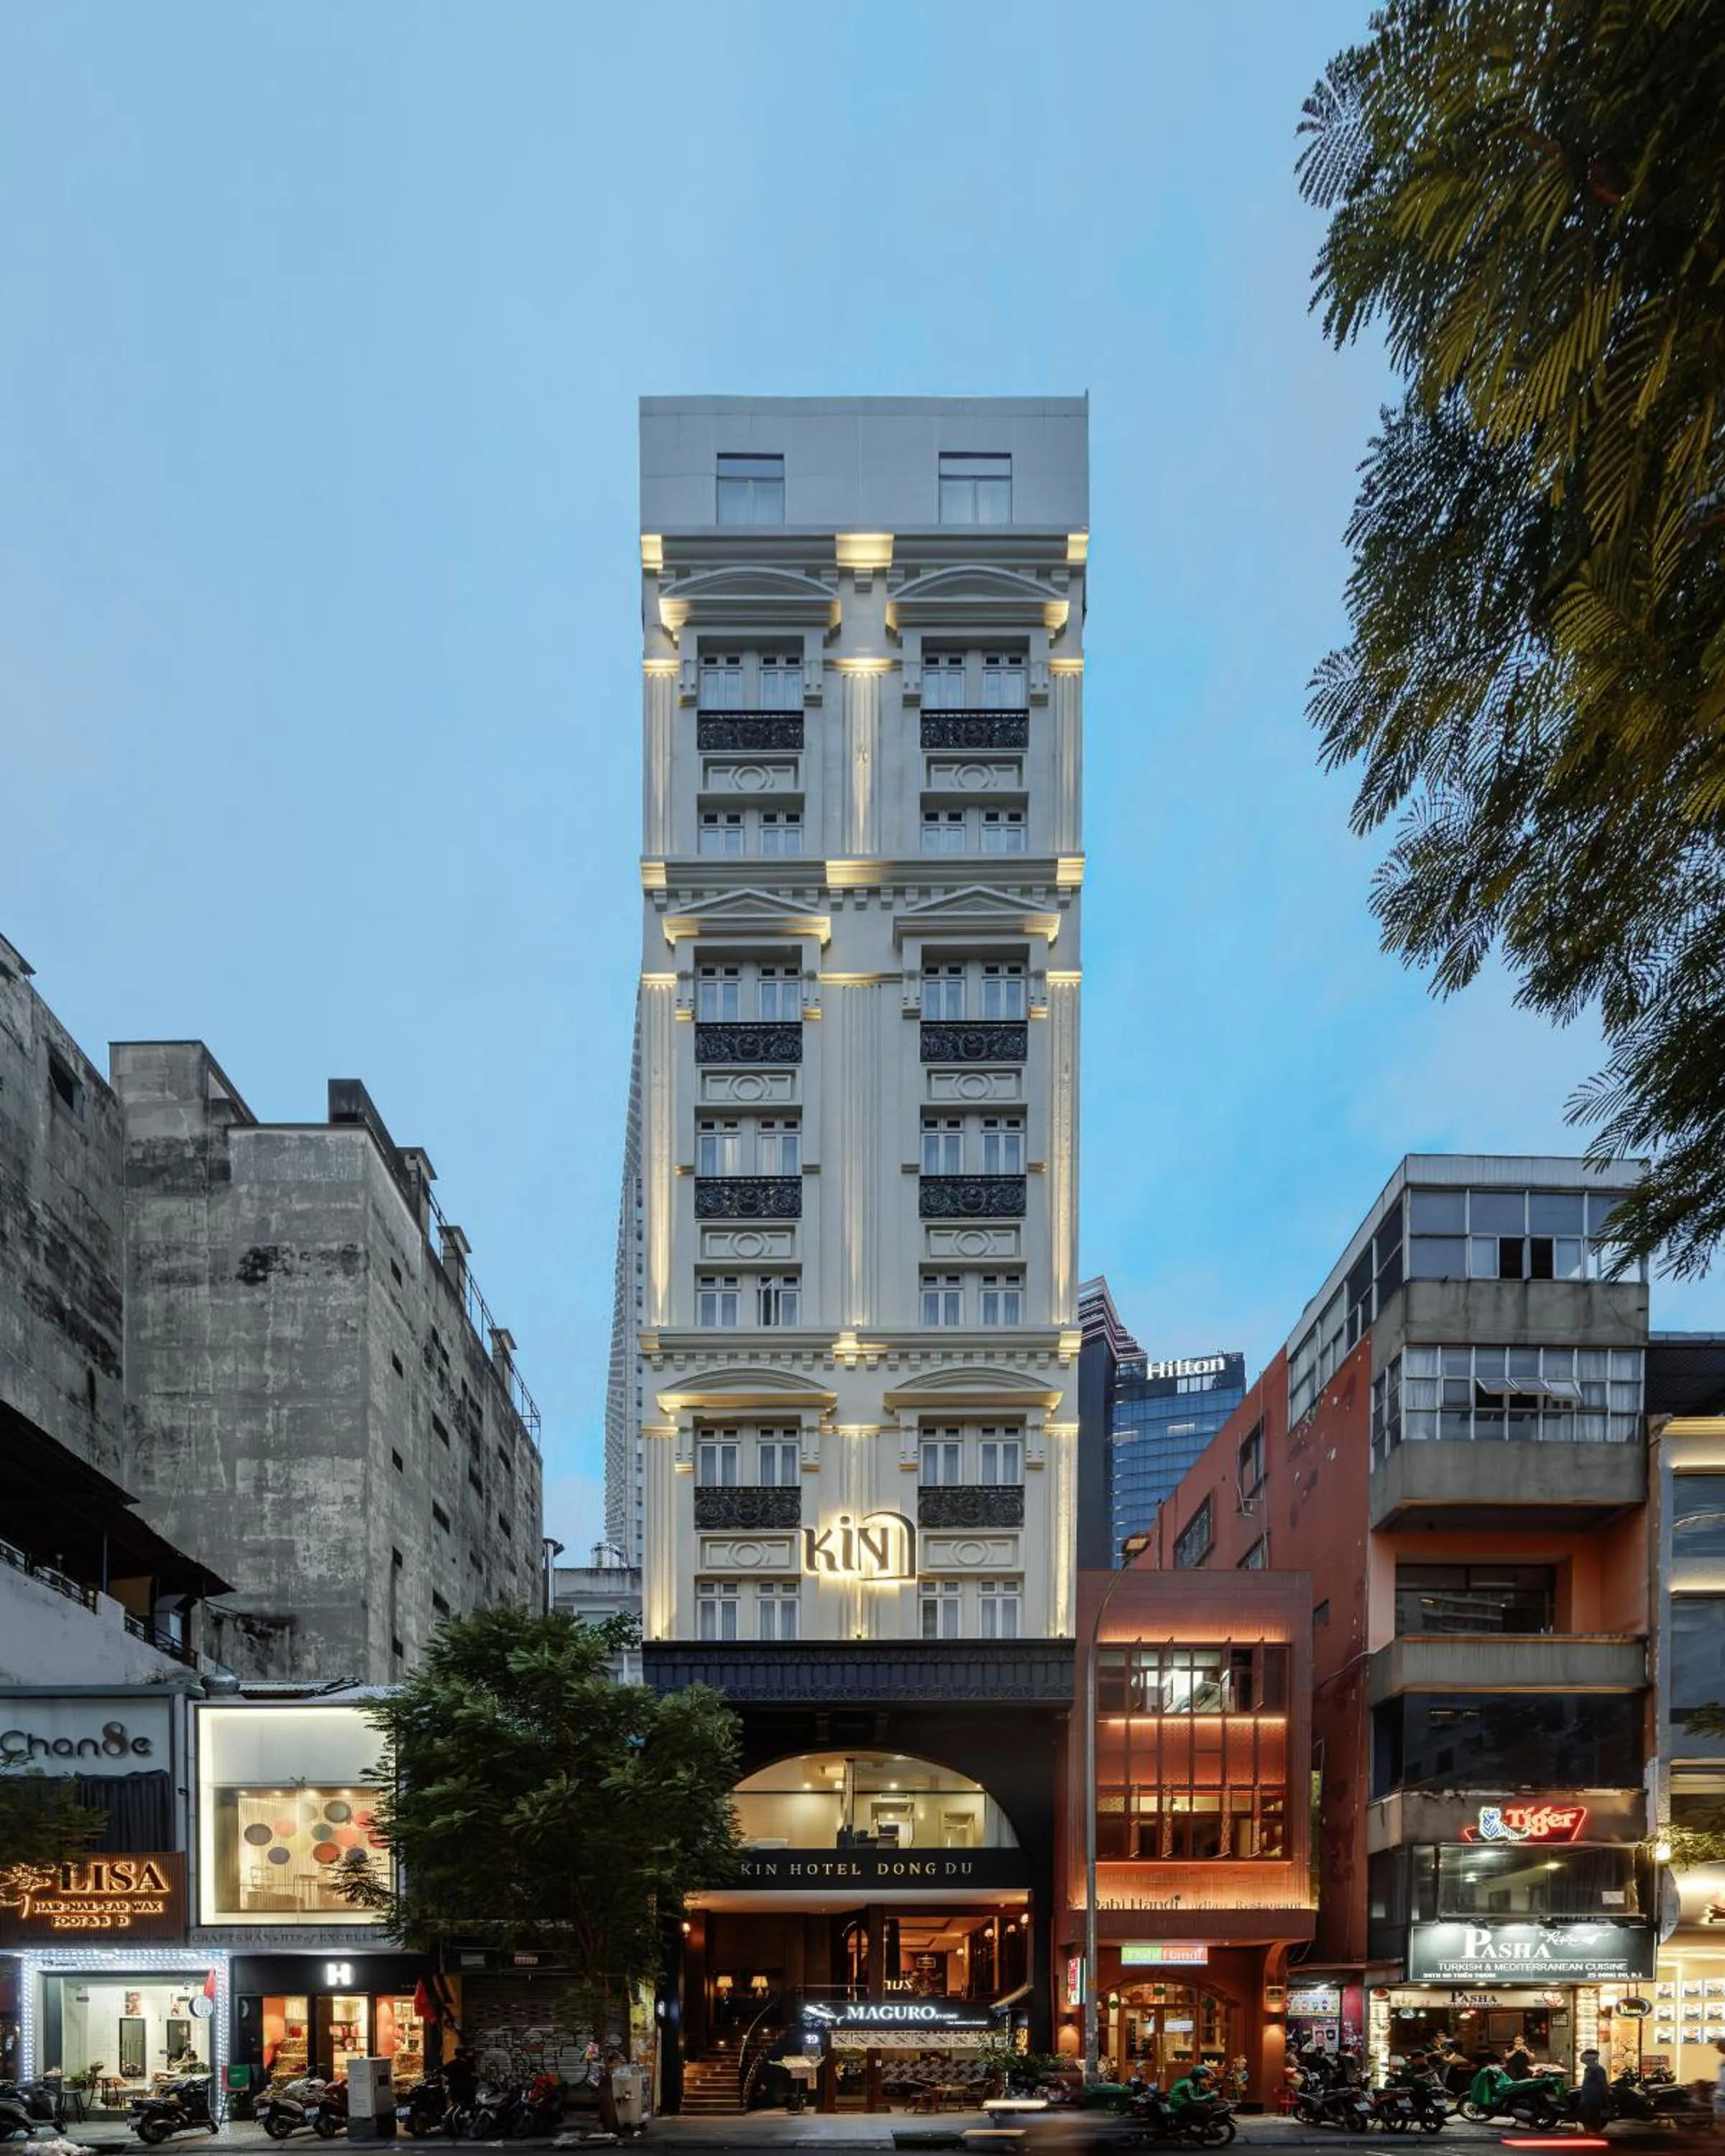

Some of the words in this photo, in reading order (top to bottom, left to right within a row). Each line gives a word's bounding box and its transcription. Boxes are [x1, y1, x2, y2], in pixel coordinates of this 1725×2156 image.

[1146, 1357, 1225, 1380] Hilton
[1506, 1807, 1576, 1836] Tiger
[740, 1863, 778, 1875] KIN
[790, 1863, 862, 1875] HOTEL
[877, 1863, 936, 1875] DONG
[944, 1862, 972, 1874] DU
[60, 1862, 170, 1892] LISA
[132, 1902, 160, 1912] WAX
[52, 1915, 84, 1926] FOOT
[1460, 1928, 1552, 1959] PASHA
[327, 1963, 351, 1986] H
[1439, 1963, 1482, 1972] TURKISH
[1484, 1963, 1492, 1972] &
[1494, 1963, 1583, 1971] MEDITERRANEAN
[1585, 1963, 1629, 1971] CUISINE
[1449, 1990, 1498, 2003] PASHA
[847, 2005, 936, 2020] MAGURO
